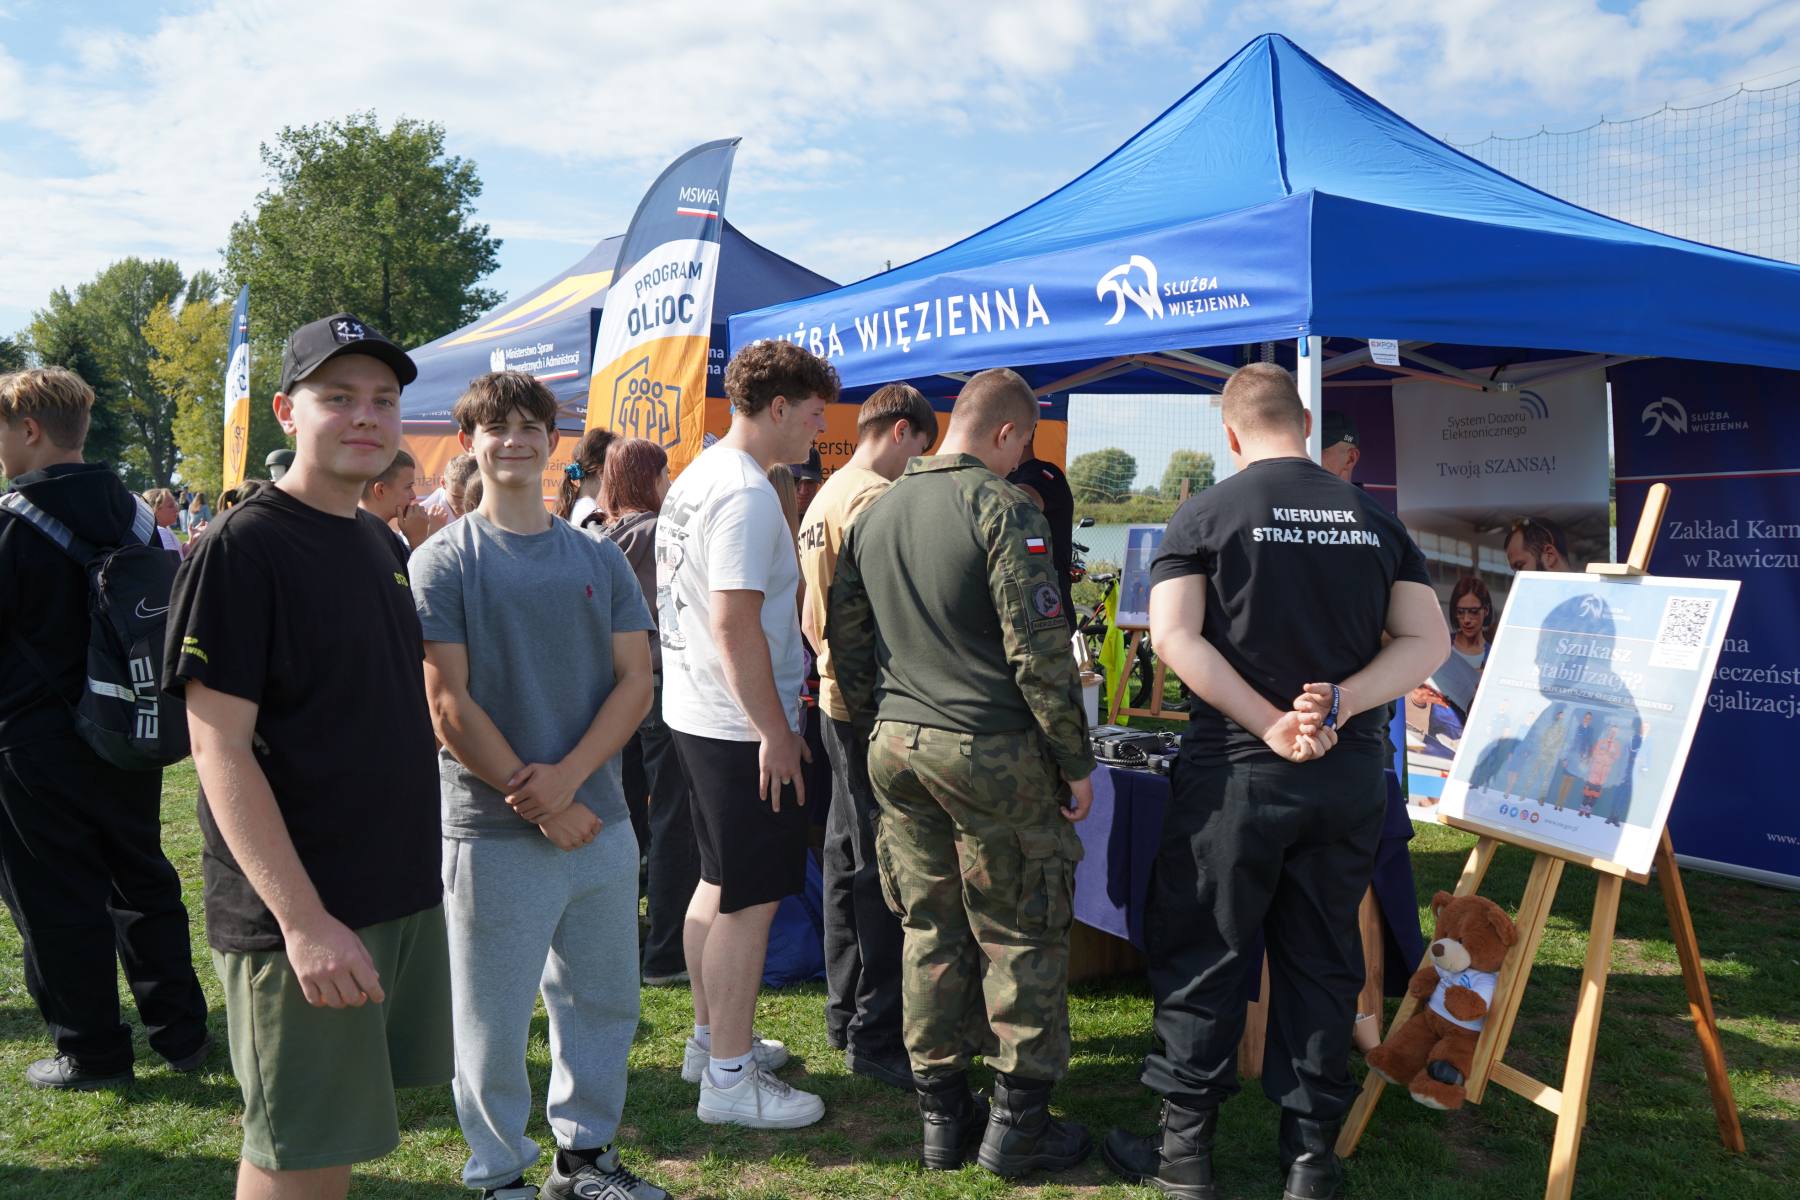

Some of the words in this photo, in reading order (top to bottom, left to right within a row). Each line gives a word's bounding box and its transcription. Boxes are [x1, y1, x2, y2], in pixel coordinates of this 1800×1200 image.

[679, 187, 720, 205] MSWiA
[634, 261, 703, 298] PROGRAM
[1163, 275, 1218, 297] SŁUŻBA
[627, 293, 695, 337] OLiOC
[1168, 293, 1250, 317] WIĘZIENNA
[752, 322, 844, 358] ŻBA
[855, 284, 1050, 353] WIĘZIENNA
[505, 346, 537, 359] Ministerstwo
[537, 343, 554, 356] Spraw
[546, 350, 580, 368] Administracji
[1447, 415, 1486, 429] System
[1488, 412, 1526, 423] Dozoru
[1691, 411, 1730, 421] SŁUŻBA
[1442, 425, 1527, 441] Elektronicznego
[1691, 422, 1749, 433] WIĘZIENNA
[1436, 460, 1481, 479] Twoją
[1485, 455, 1556, 475] SZANSĄ!
[1272, 507, 1357, 523] KIERUNEK
[1253, 526, 1304, 543] STRAŻ
[1307, 527, 1380, 547] POŻARNA
[1669, 519, 1738, 540] Zakład
[1746, 519, 1800, 539] Karn
[1683, 553, 1701, 568] w
[1706, 548, 1800, 568] Rawiczu
[1555, 638, 1632, 662] Szukasz
[129, 656, 159, 738] ELITE
